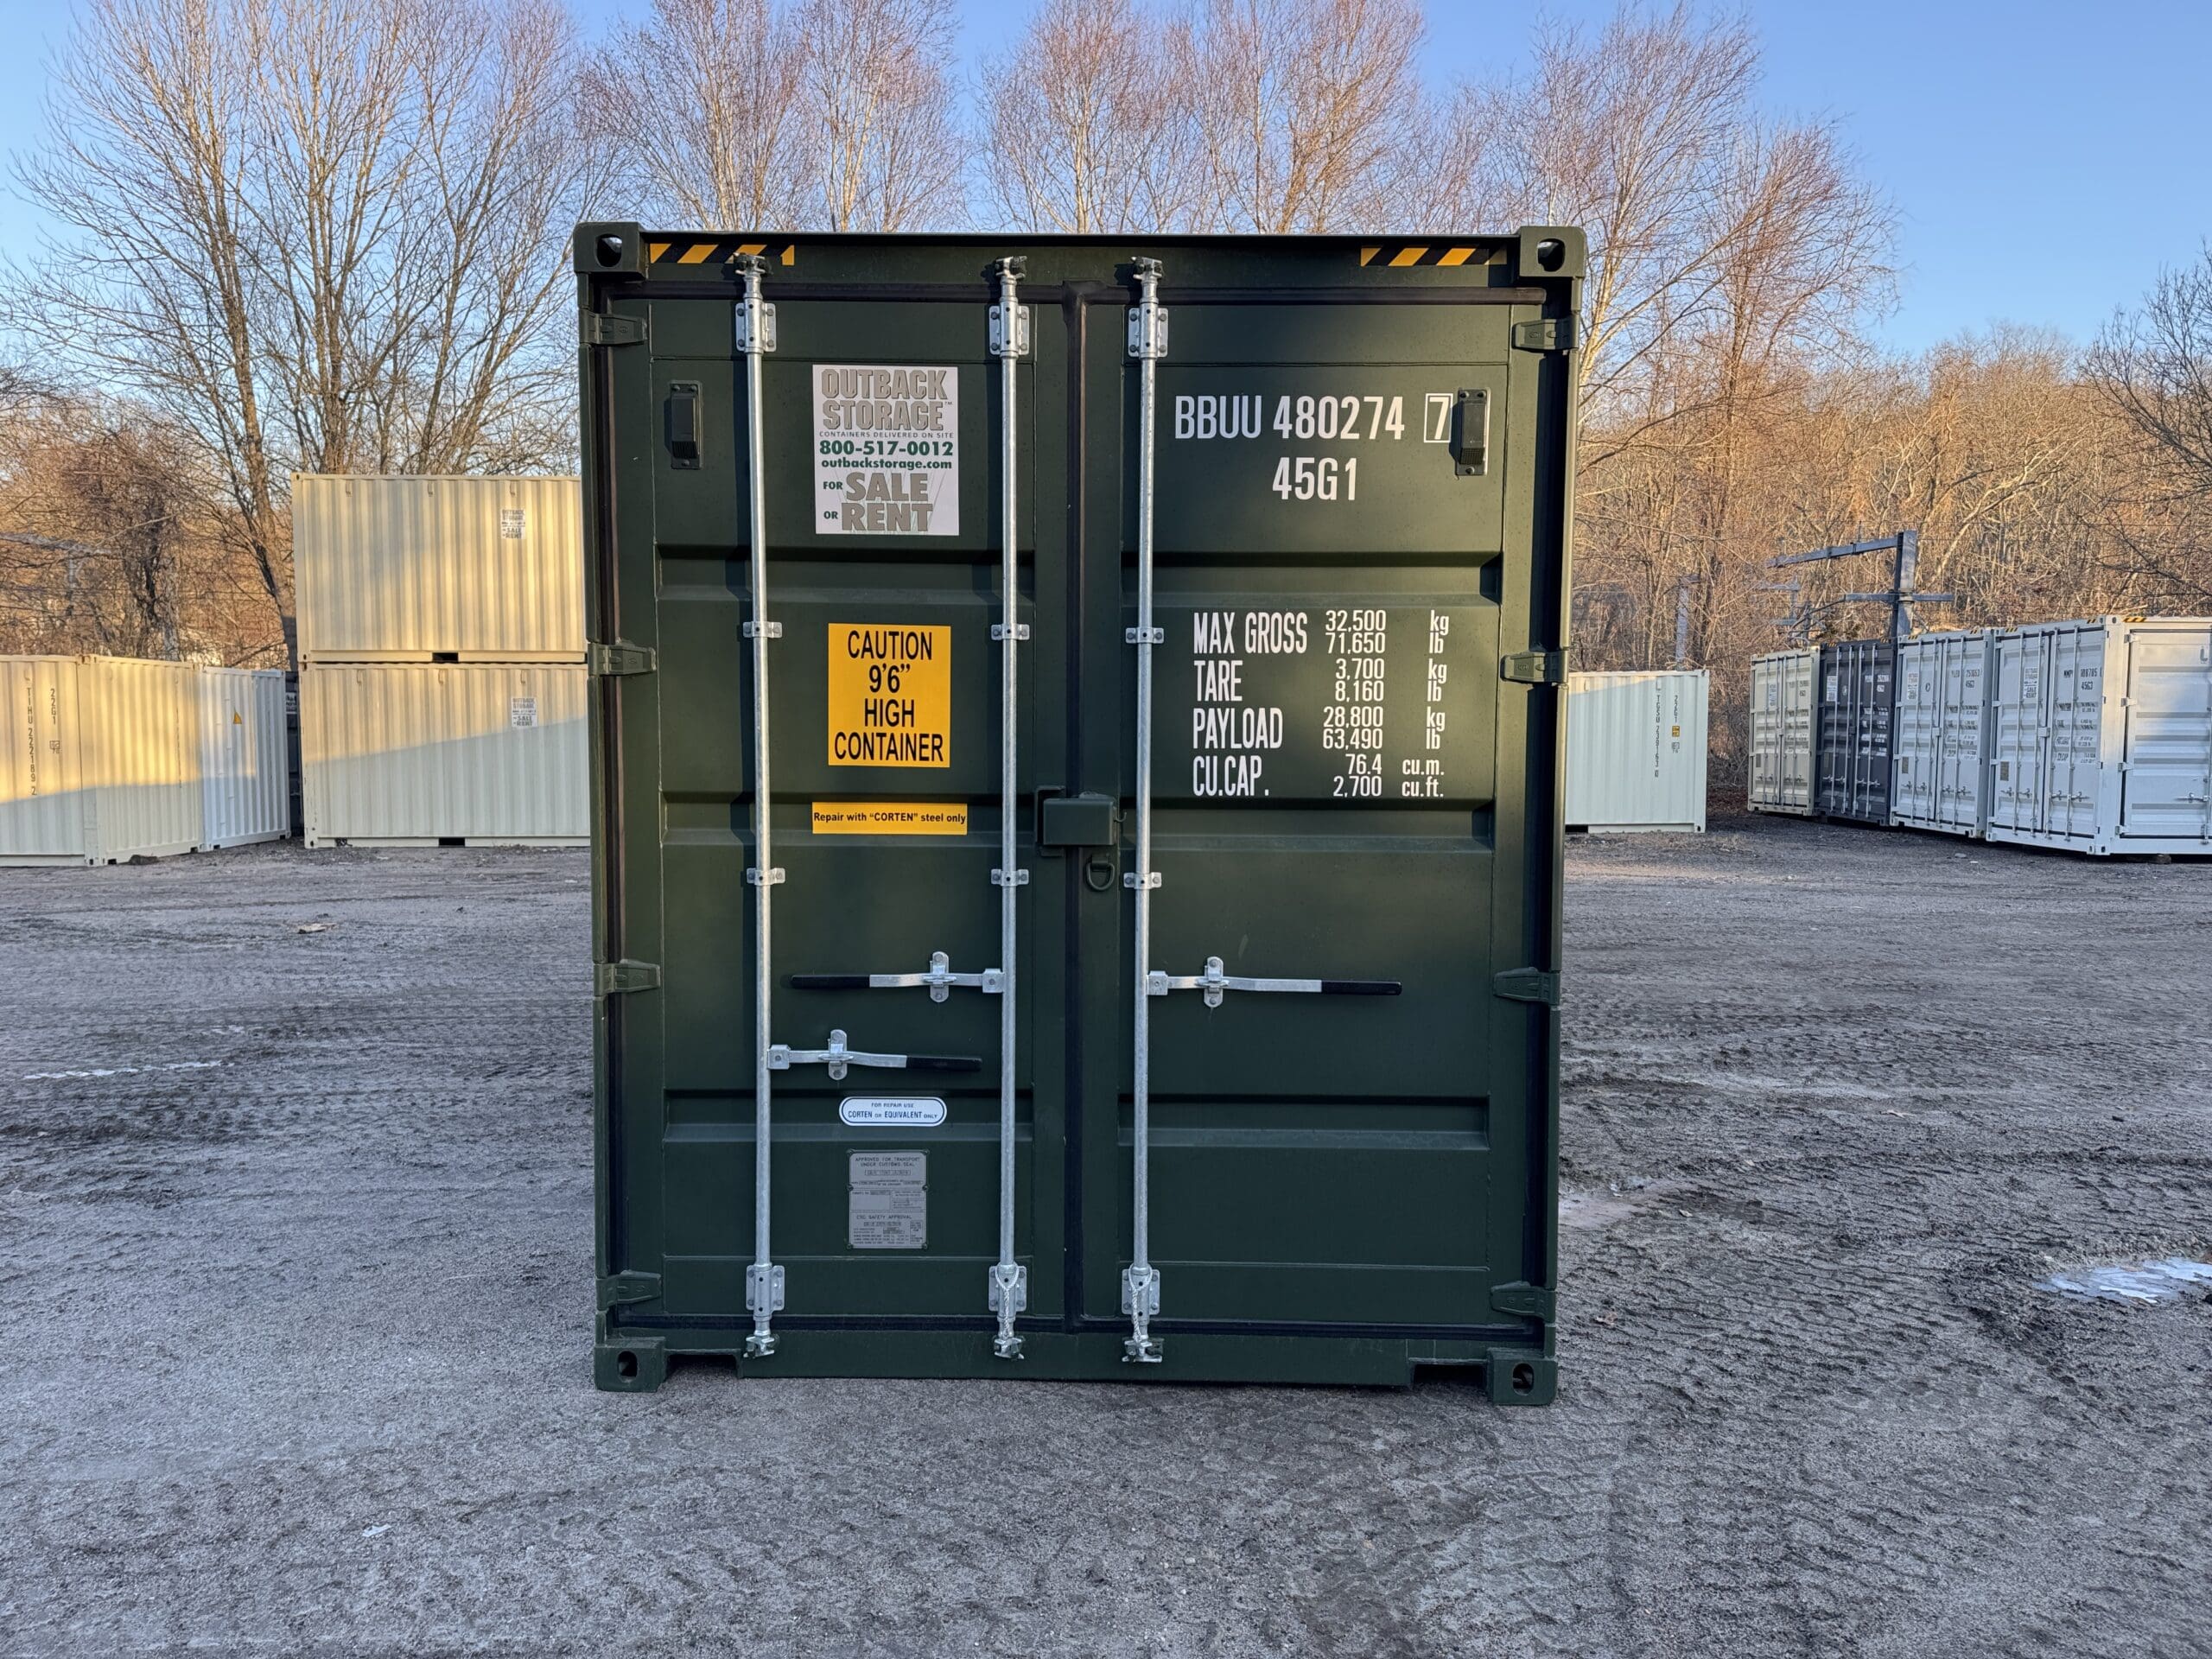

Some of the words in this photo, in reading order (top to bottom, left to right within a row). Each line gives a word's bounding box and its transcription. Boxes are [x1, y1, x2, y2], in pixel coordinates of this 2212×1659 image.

[821, 369, 948, 399] OUTBACK
[823, 400, 944, 430] STORAGE
[1175, 395, 1262, 439] BBUU
[1274, 396, 1404, 440] 480274
[1428, 397, 1451, 440] 7
[820, 440, 953, 456] 800-517-0012
[822, 457, 952, 471] outbackstorage.com
[823, 481, 842, 490] FOR
[846, 472, 928, 501] SALE
[1273, 457, 1357, 501] 45G1
[823, 511, 838, 519] OR
[842, 503, 933, 531] RENT
[848, 630, 932, 660] CAUTION
[1193, 612, 1235, 654] MAX
[1245, 613, 1307, 654] GROSS
[1325, 610, 1386, 632] 32,500
[1430, 610, 1449, 635] kg
[1325, 632, 1386, 654] 71,650
[1429, 632, 1444, 654] lb
[1193, 660, 1243, 702] TARE
[1335, 658, 1384, 680] 3,700
[1427, 658, 1447, 683] kg
[1335, 680, 1384, 702] 8,160
[1427, 680, 1442, 702] lb
[864, 698, 914, 728] HIGH
[1193, 708, 1283, 749] PAYLOAD
[1323, 706, 1383, 728] 28,800
[1427, 706, 1446, 731] kg
[835, 732, 944, 762] CONTAINER
[1323, 728, 1382, 749] 63,490
[1426, 728, 1440, 749] lb
[1193, 755, 1269, 797] CU.CAP.
[1345, 753, 1382, 775] 76.4
[1402, 759, 1445, 776] cu.m.
[1333, 776, 1382, 798] 2,700
[1402, 776, 1444, 798] cu.ft.
[31, 785, 37, 796] 2
[814, 812, 843, 823] Repair
[847, 812, 867, 821] with
[920, 813, 943, 823] steel
[946, 813, 966, 824] only
[884, 1110, 922, 1119] EQUIVALENT
